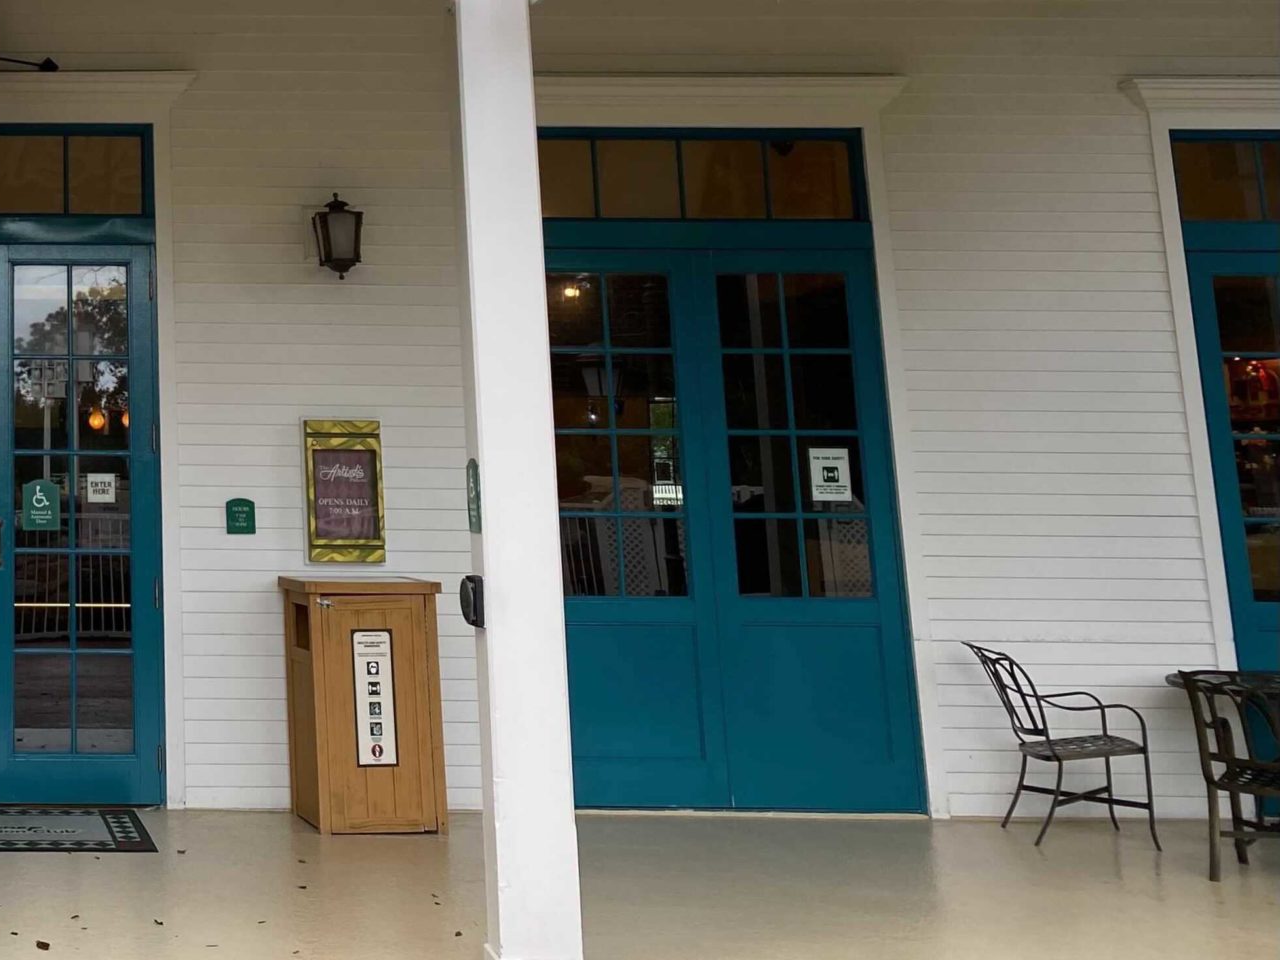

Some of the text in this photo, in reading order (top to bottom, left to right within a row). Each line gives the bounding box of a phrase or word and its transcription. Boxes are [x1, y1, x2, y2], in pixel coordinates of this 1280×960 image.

[92, 488, 111, 496] HERE
[318, 497, 369, 506] OPENS DAILY
